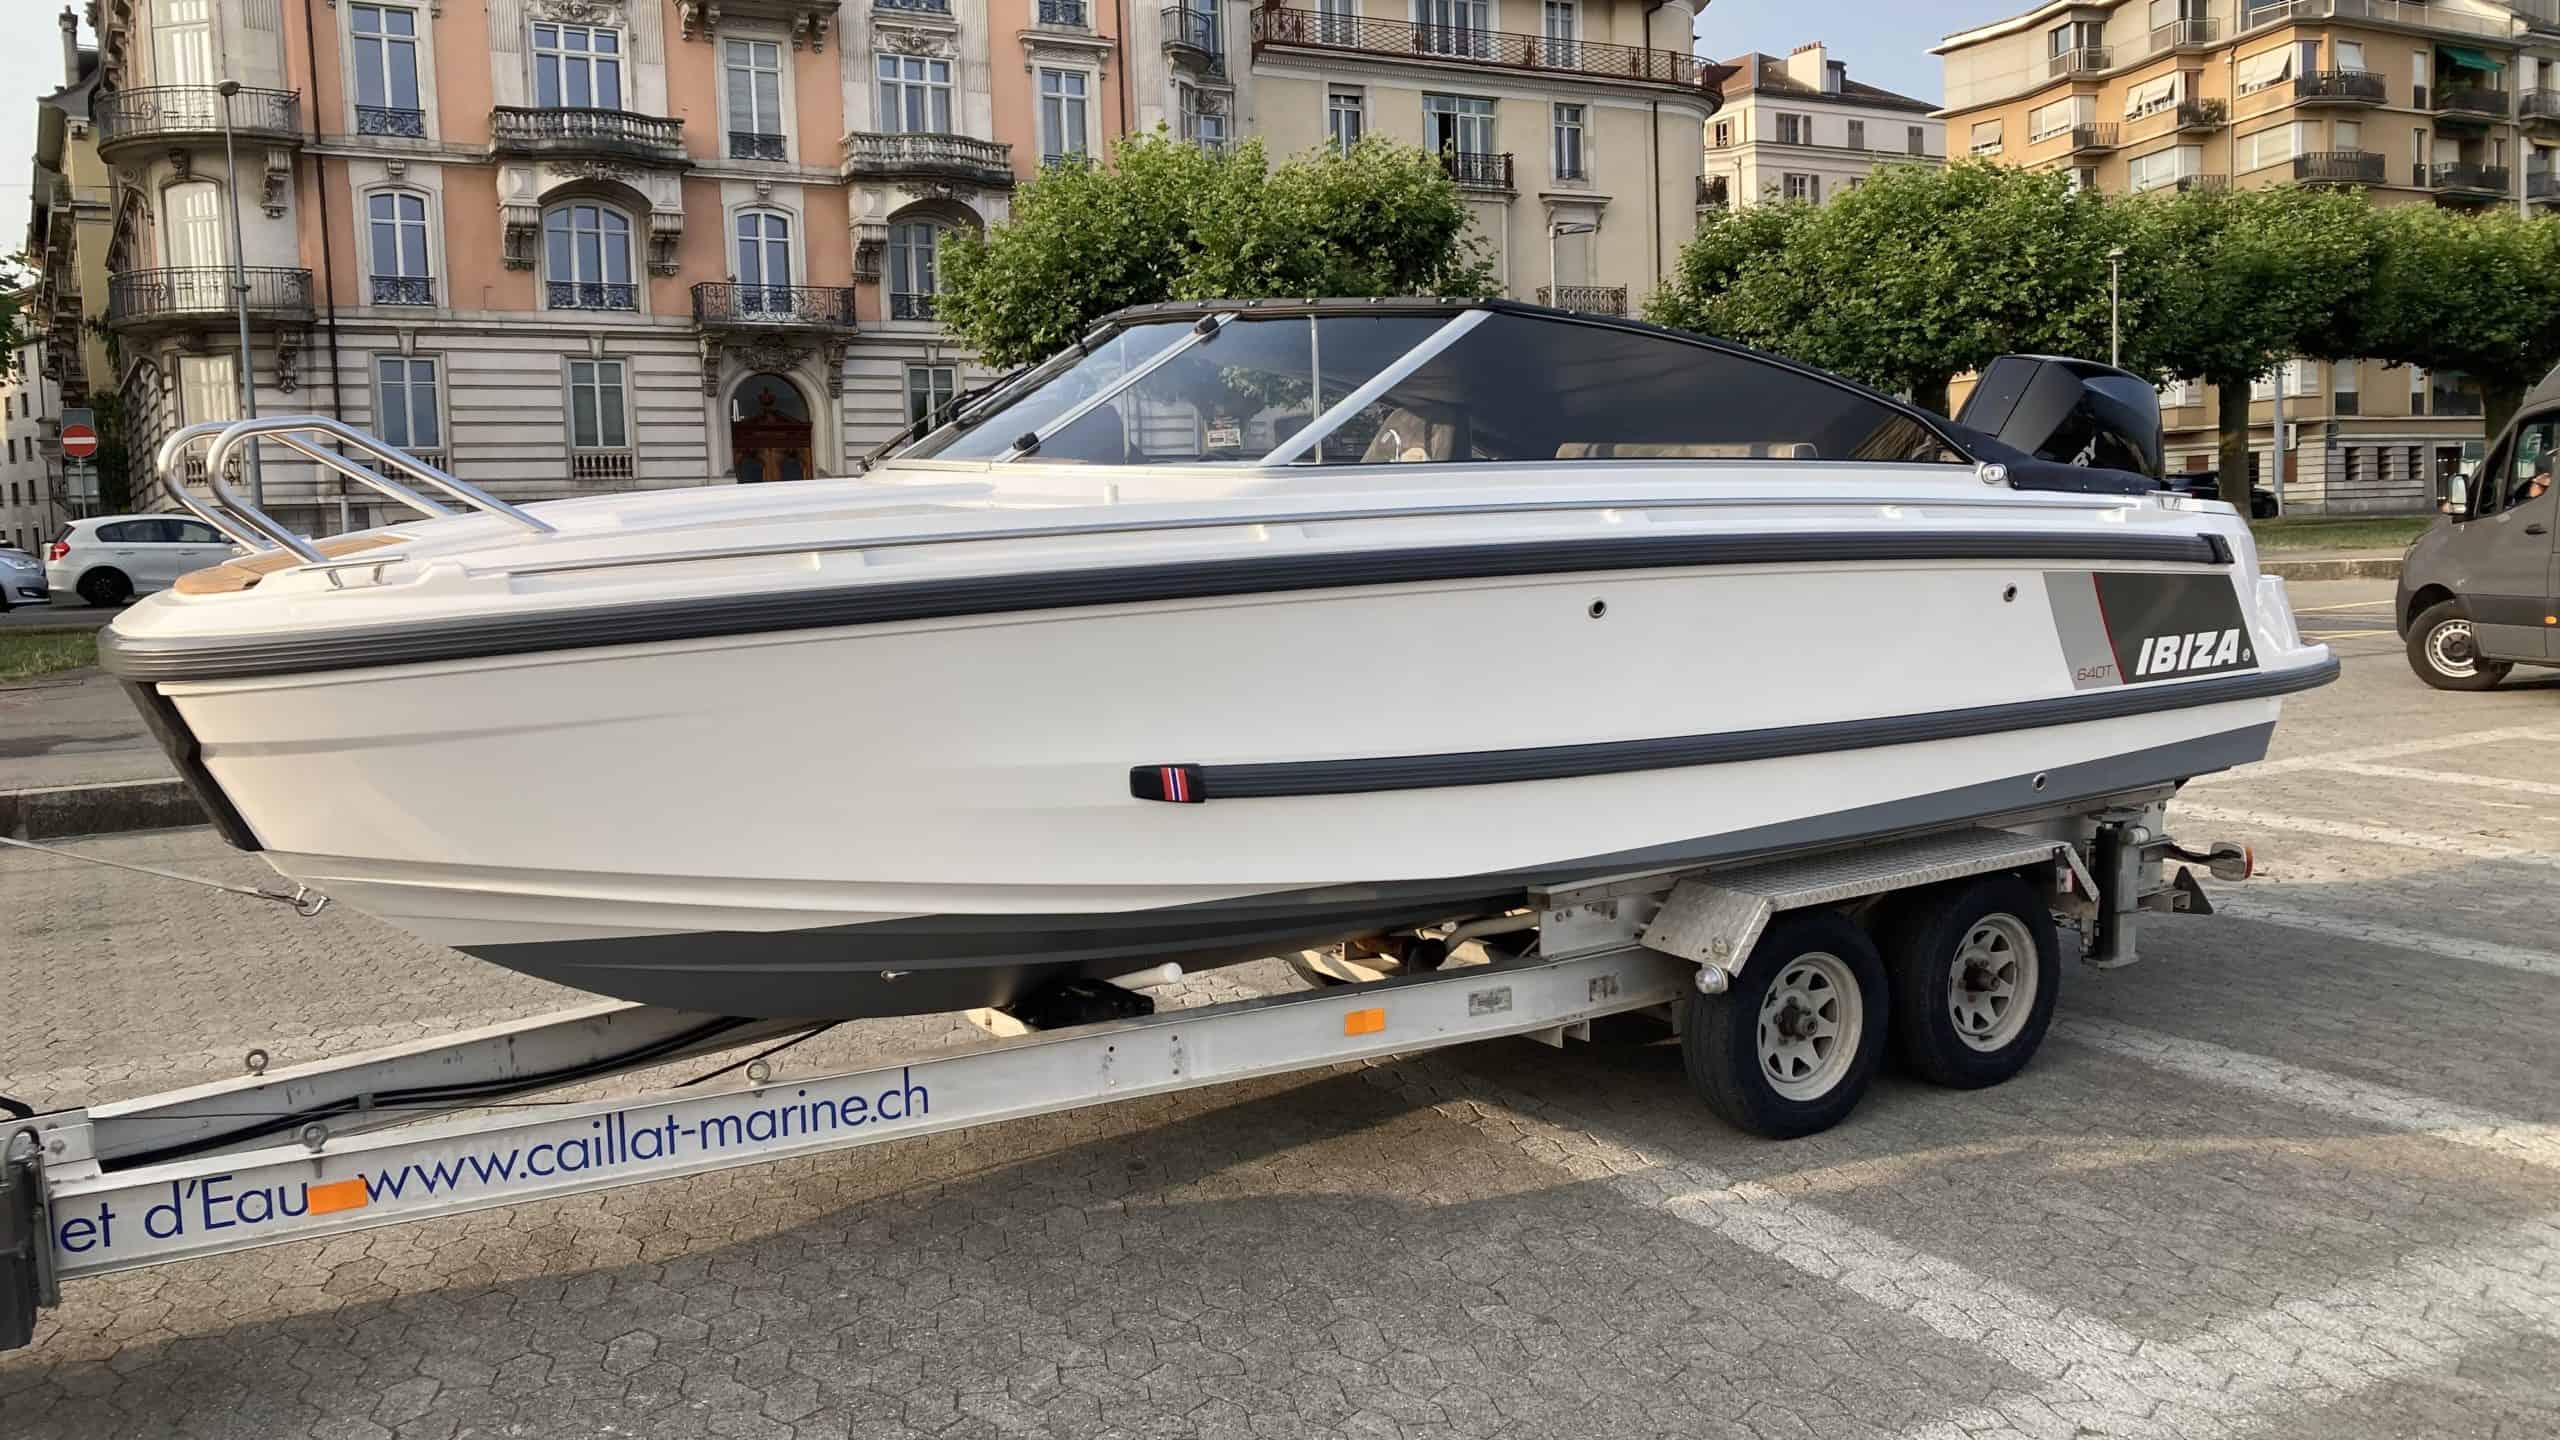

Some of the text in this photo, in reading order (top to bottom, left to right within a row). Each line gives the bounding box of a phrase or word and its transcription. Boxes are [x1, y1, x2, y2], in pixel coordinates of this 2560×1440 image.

[2077, 664, 2113, 681] 640T
[2136, 629, 2240, 676] IBIZA
[357, 1066, 929, 1203] www.caillat-marine.ch
